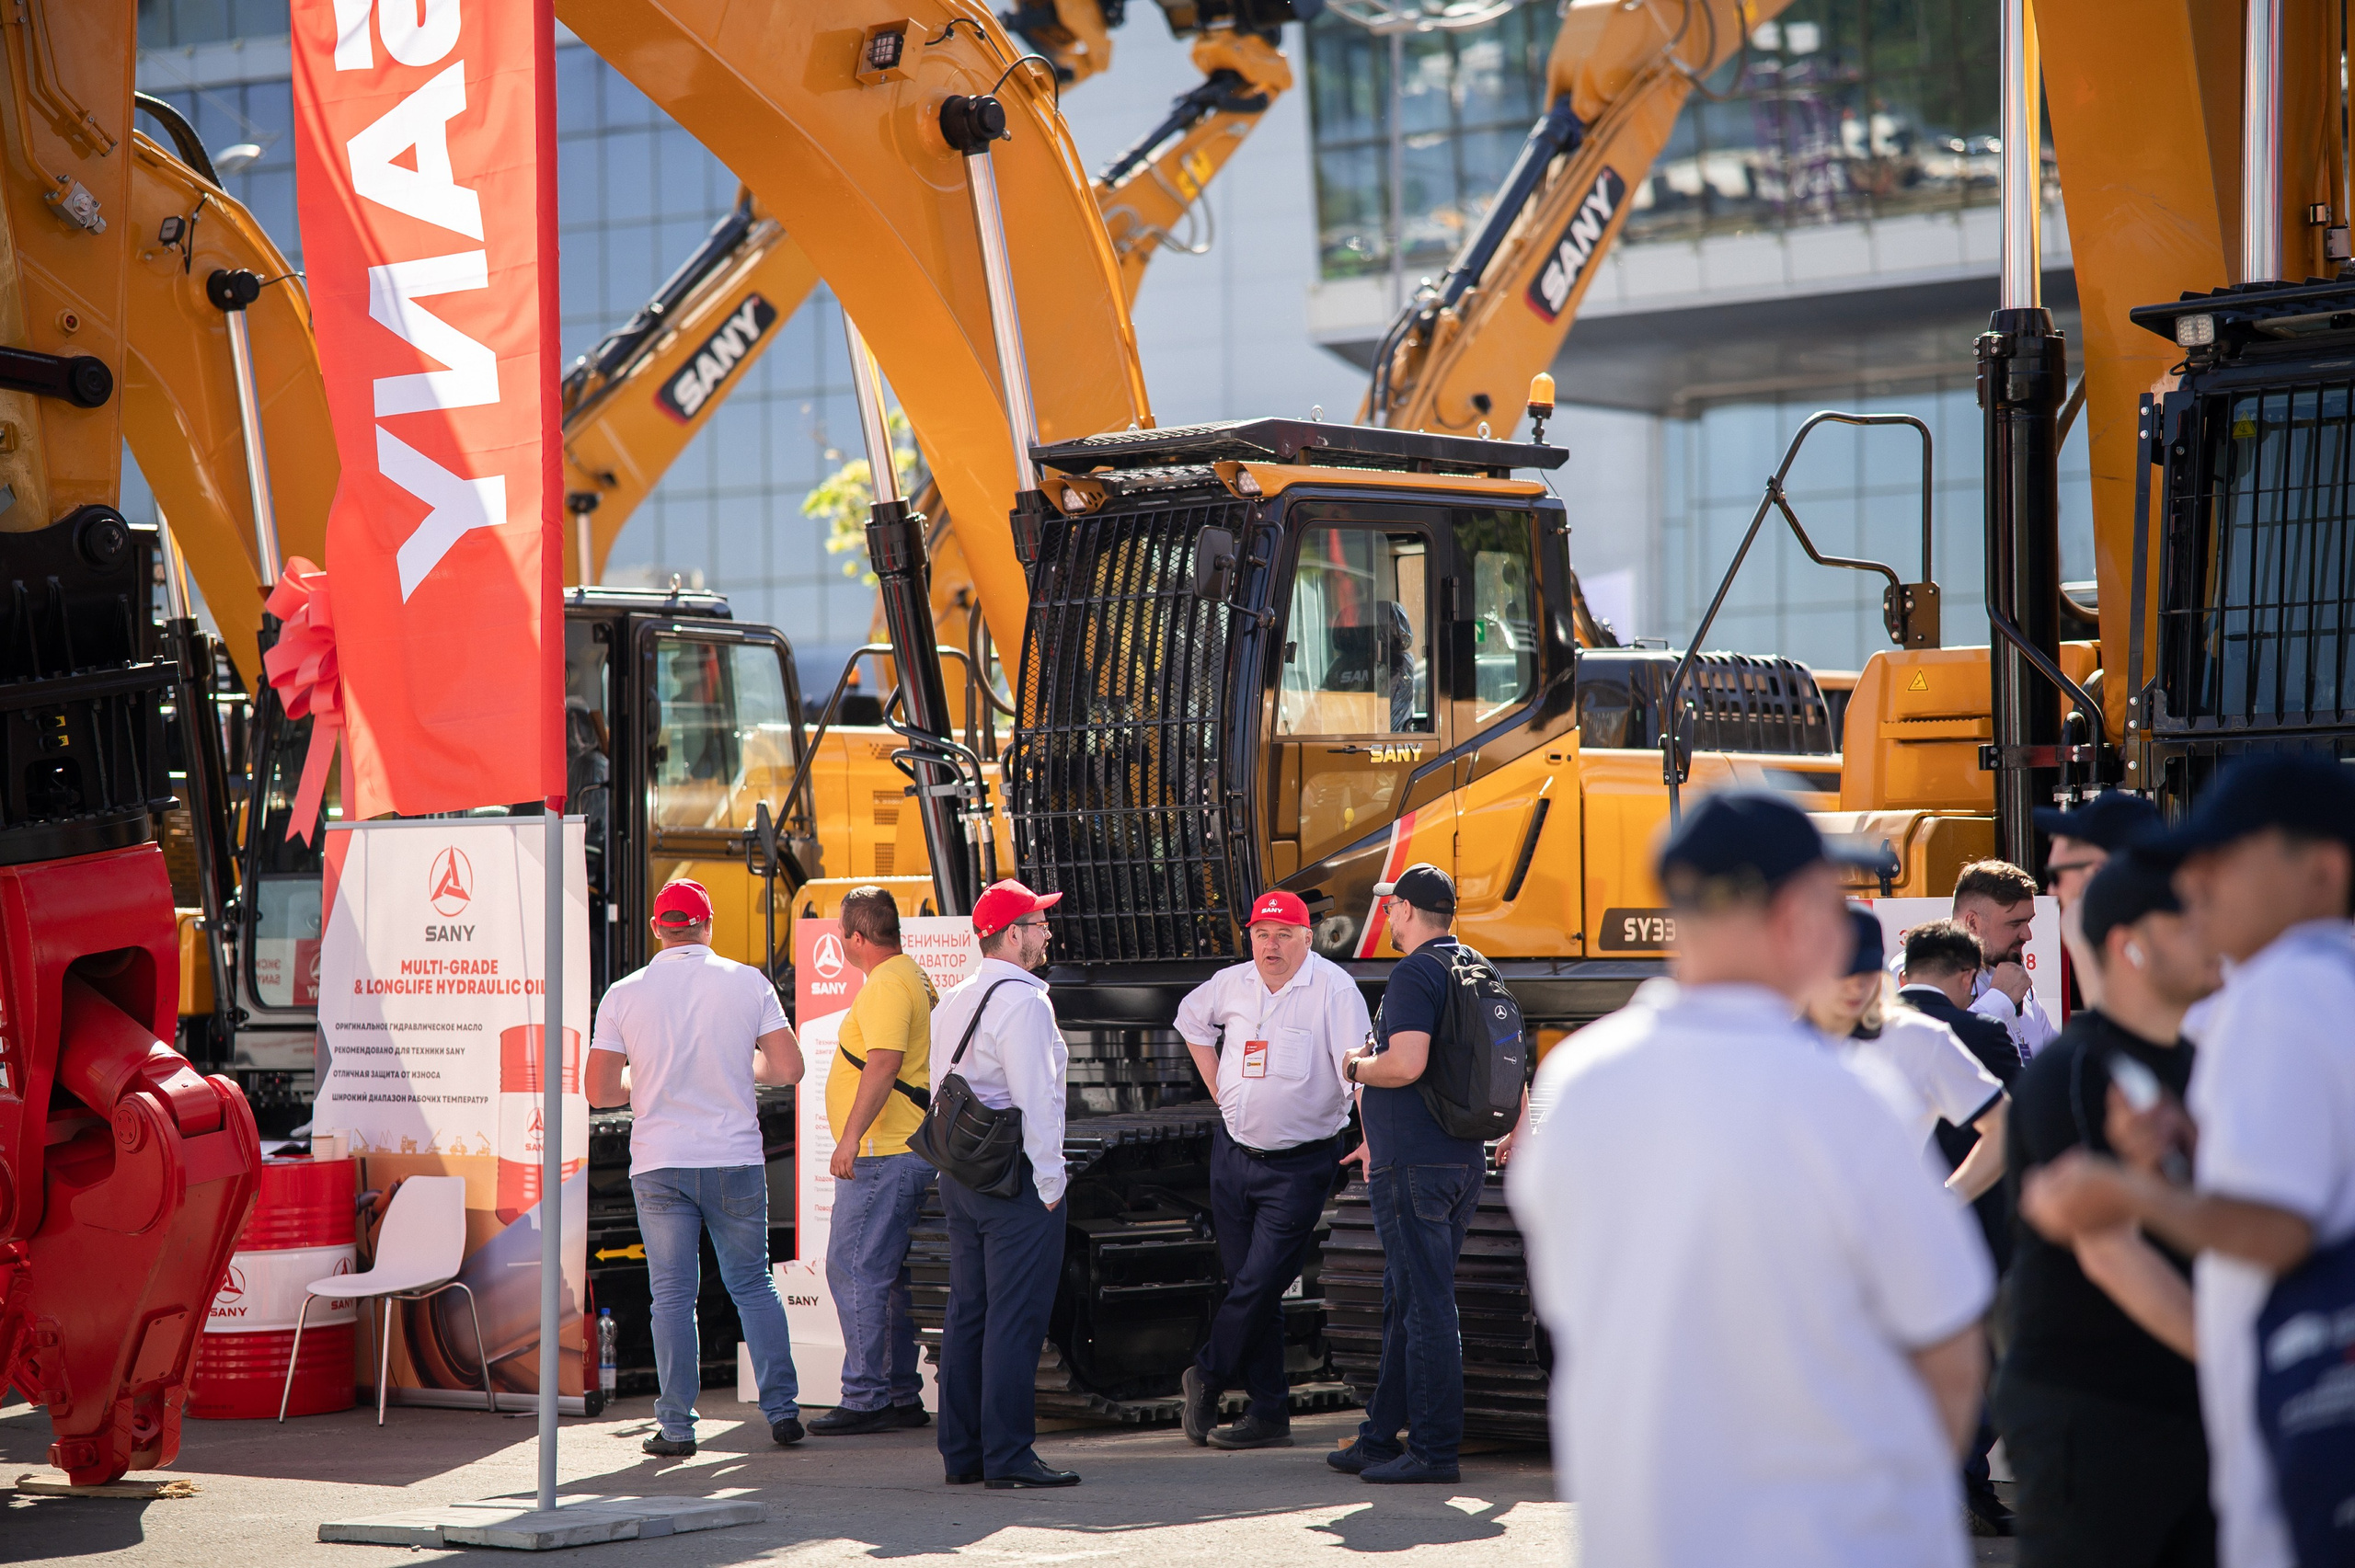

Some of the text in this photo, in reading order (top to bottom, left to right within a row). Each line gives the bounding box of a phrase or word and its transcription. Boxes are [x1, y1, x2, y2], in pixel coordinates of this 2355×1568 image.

[1541, 175, 1613, 313] SANY
[673, 299, 760, 417] SANY
[1340, 670, 1369, 683] SAN
[1370, 743, 1422, 763] SANY
[425, 925, 476, 942] SANY
[1624, 917, 1676, 942] SY33
[901, 930, 971, 948] СЕНИЧНЫЙ
[401, 959, 499, 975] MULTI-GRADE
[911, 954, 967, 967] АВАТОР
[354, 979, 546, 994] & LONGLIFE HYDRAULIC OIL
[811, 981, 847, 995] SANY
[389, 1023, 455, 1031] ГИДРАВЛИЧЕСКОЕ
[334, 1047, 393, 1055] РЕКОМЕНДОВАНО
[395, 1047, 410, 1055] ДЛЯ
[371, 1070, 399, 1079] ЗАЩИТА
[332, 1092, 367, 1101] ШИРОКИЙ
[525, 1143, 545, 1151] SAN
[331, 1299, 354, 1310] SANY
[787, 1295, 819, 1306] SANY
[210, 1307, 248, 1317] SANY
